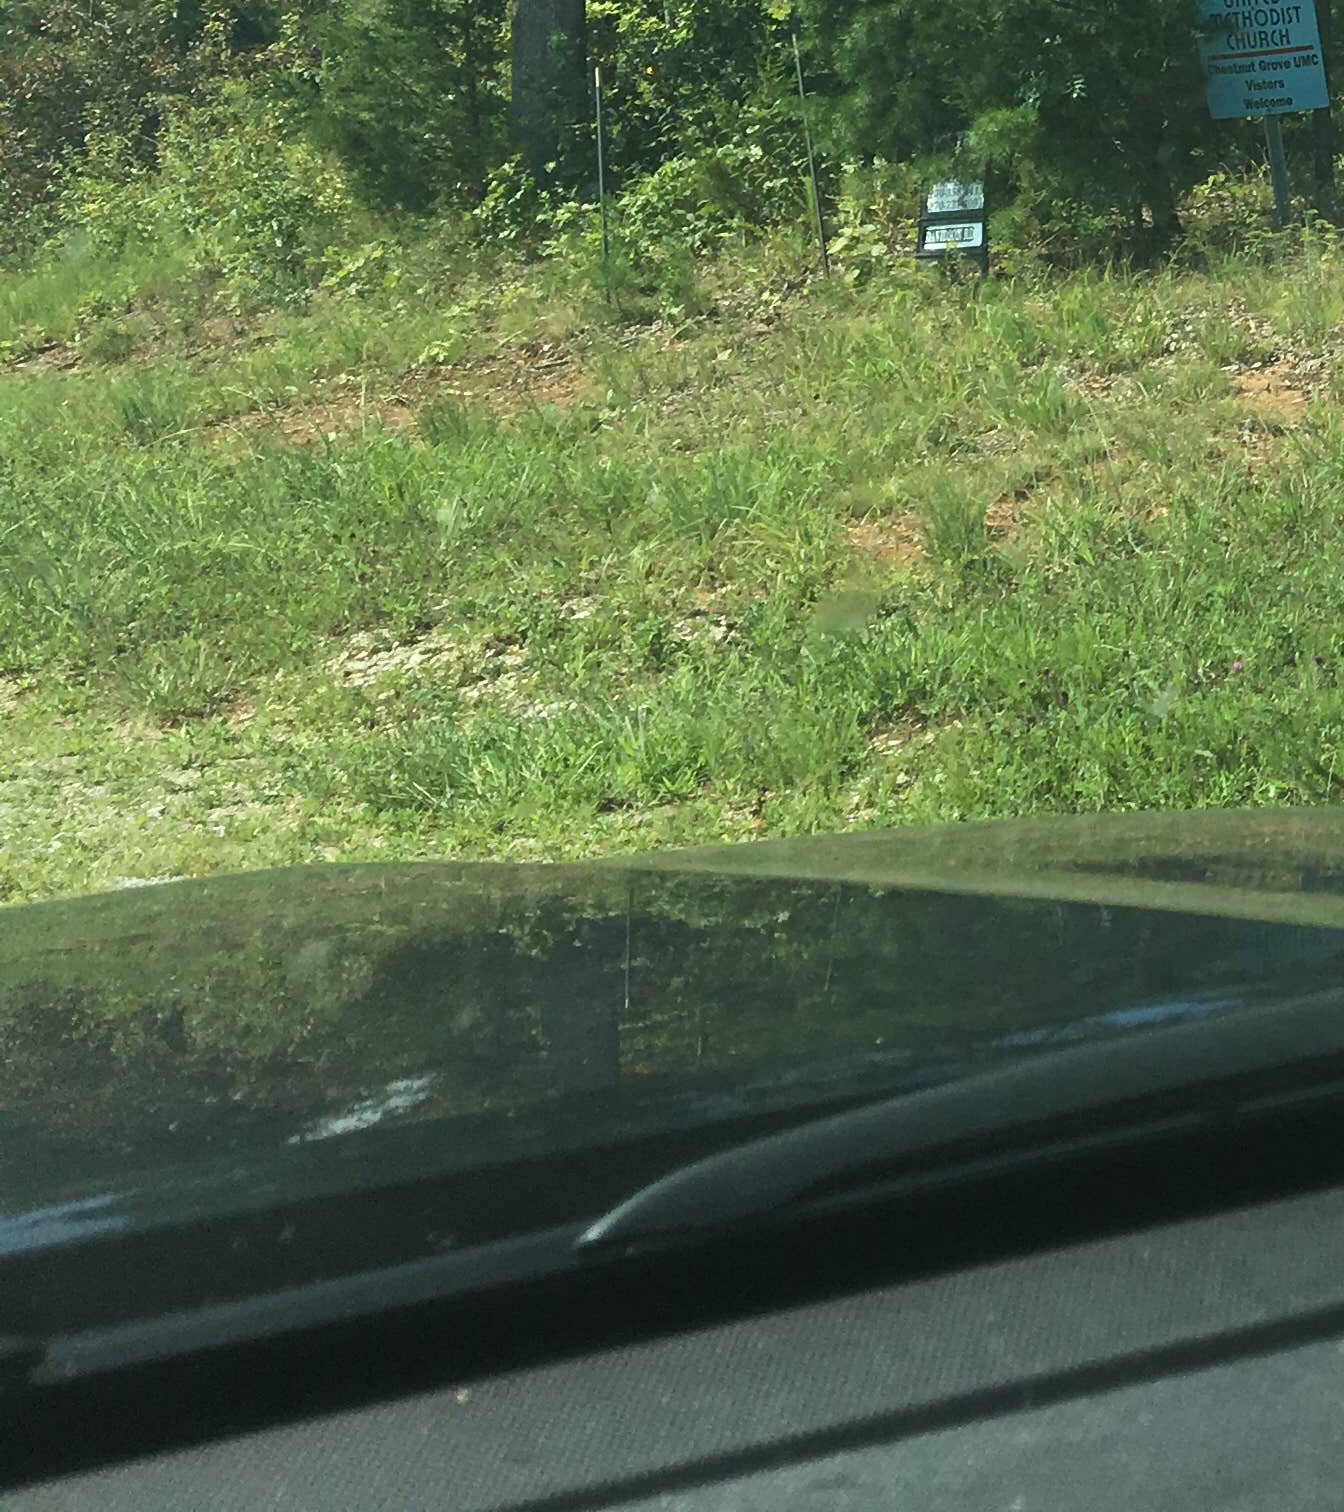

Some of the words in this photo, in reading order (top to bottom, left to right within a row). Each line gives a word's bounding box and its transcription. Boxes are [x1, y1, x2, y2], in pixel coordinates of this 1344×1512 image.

[1227, 28, 1291, 50] CHURCH
[1258, 60, 1291, 71] Grove
[1293, 54, 1319, 68] UMC
